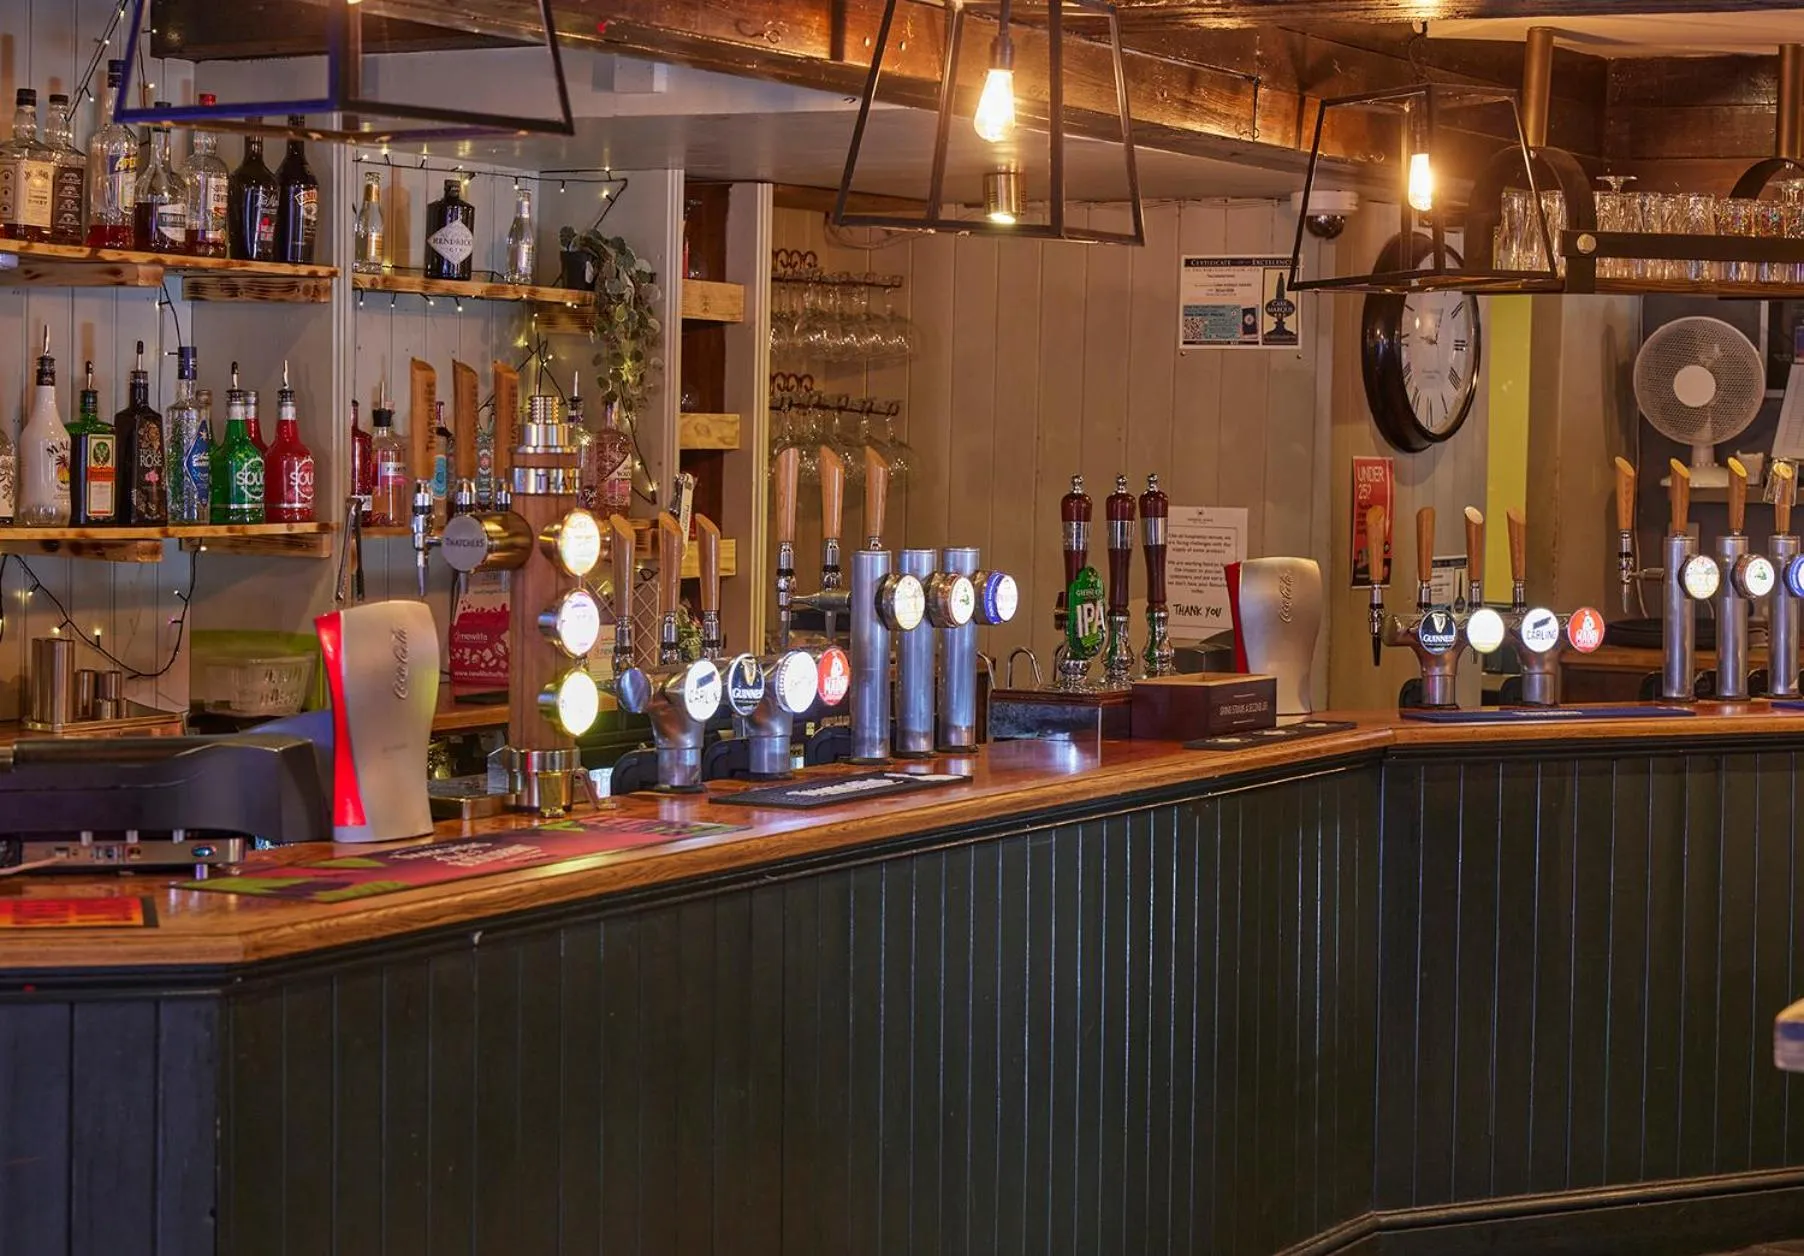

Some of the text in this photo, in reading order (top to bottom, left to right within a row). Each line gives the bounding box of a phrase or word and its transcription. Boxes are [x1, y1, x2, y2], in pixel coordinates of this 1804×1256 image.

[1357, 466, 1385, 482] UNDER
[1358, 483, 1372, 499] 25?
[1173, 603, 1222, 618] THANK YOU
[1076, 600, 1105, 638] IPA
[1526, 630, 1557, 641] CARLING
